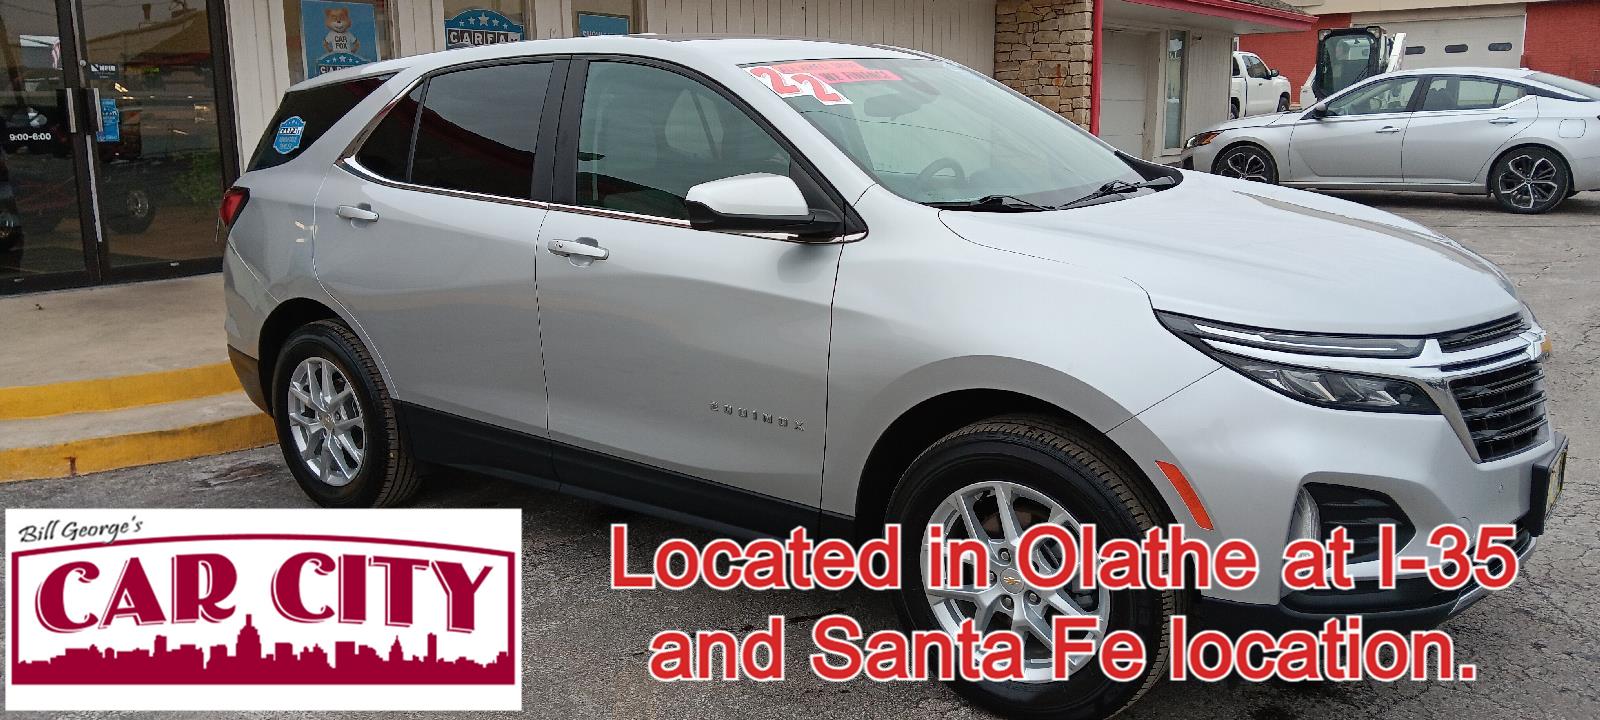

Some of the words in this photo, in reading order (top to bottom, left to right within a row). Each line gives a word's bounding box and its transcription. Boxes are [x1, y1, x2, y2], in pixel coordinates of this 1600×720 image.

[750, 67, 843, 102] 22
[9, 132, 52, 141] 9:00-6:00
[710, 401, 805, 431] EQUINOX
